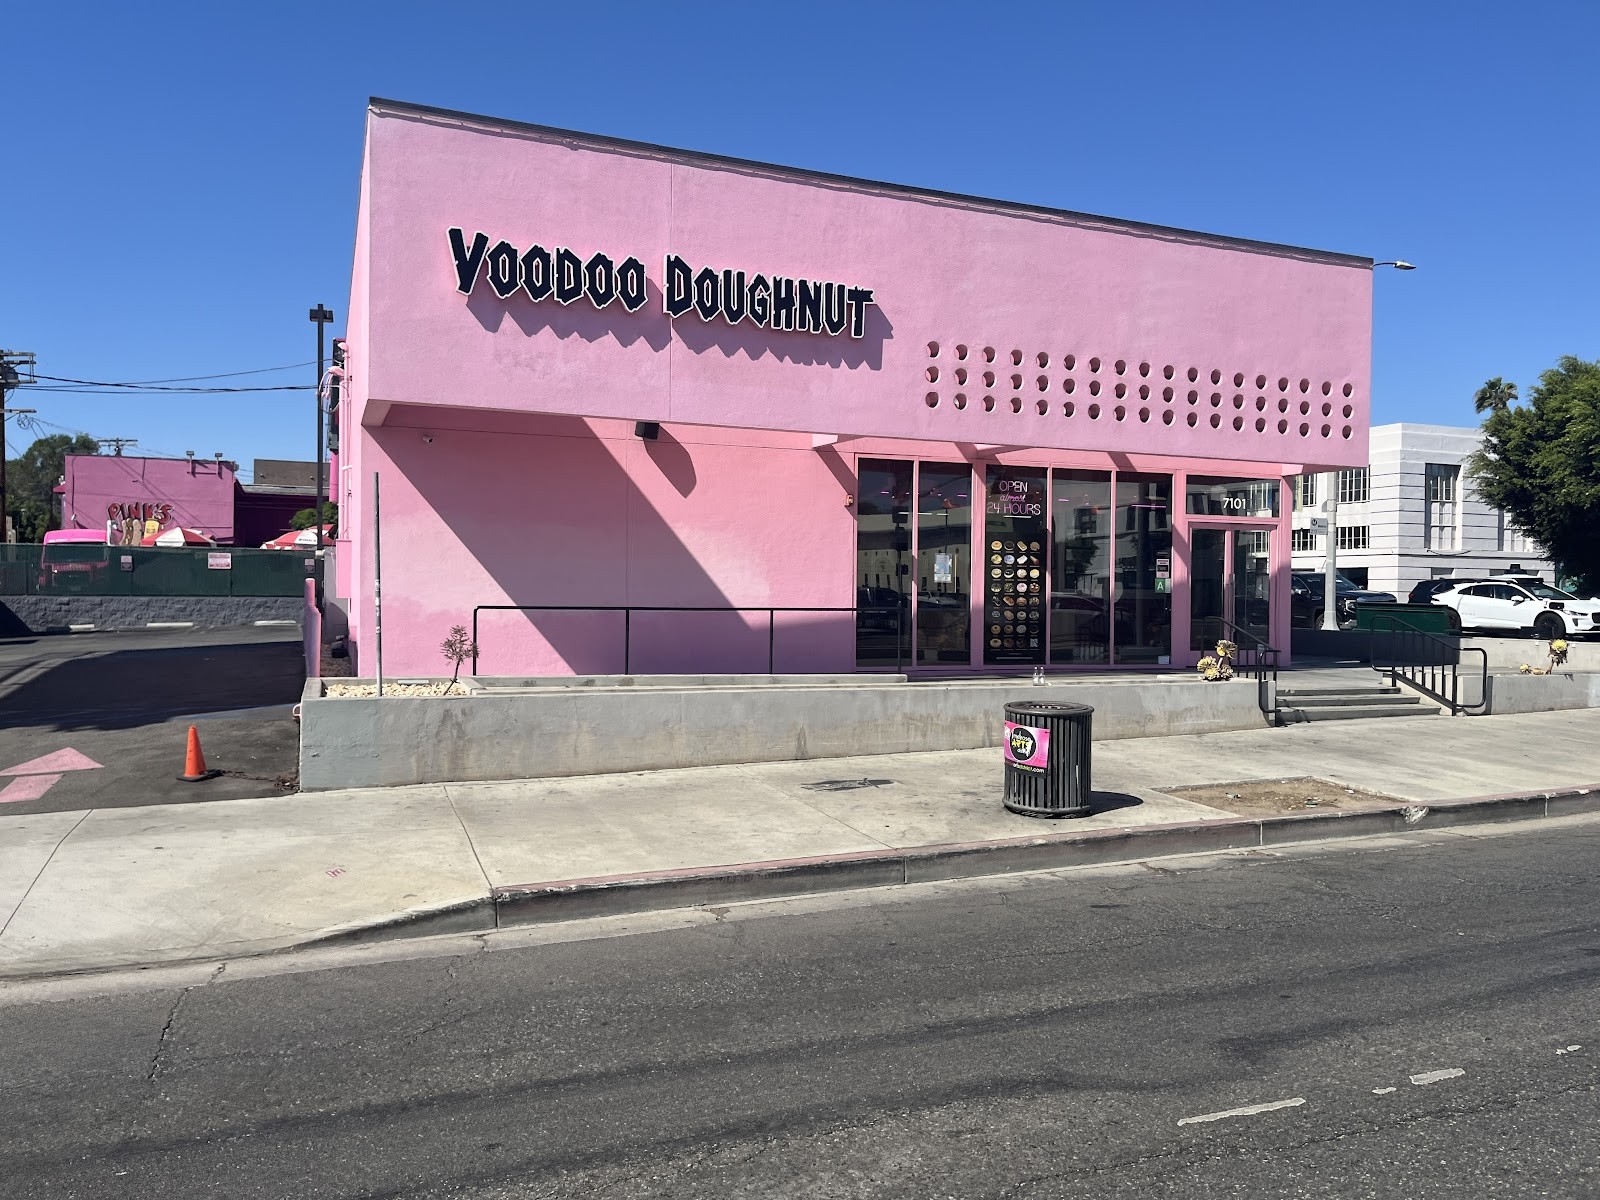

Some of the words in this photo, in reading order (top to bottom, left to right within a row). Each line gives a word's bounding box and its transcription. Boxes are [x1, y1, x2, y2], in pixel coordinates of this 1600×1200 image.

[447, 226, 649, 313] VOODOO
[662, 252, 875, 339] DOUGHNUT
[1000, 480, 1028, 493] OPEN
[986, 502, 1001, 514] 24
[1003, 503, 1041, 516] HOURS
[1222, 497, 1247, 510] 7101
[107, 502, 174, 525] PINK'S
[1156, 581, 1165, 591] A
